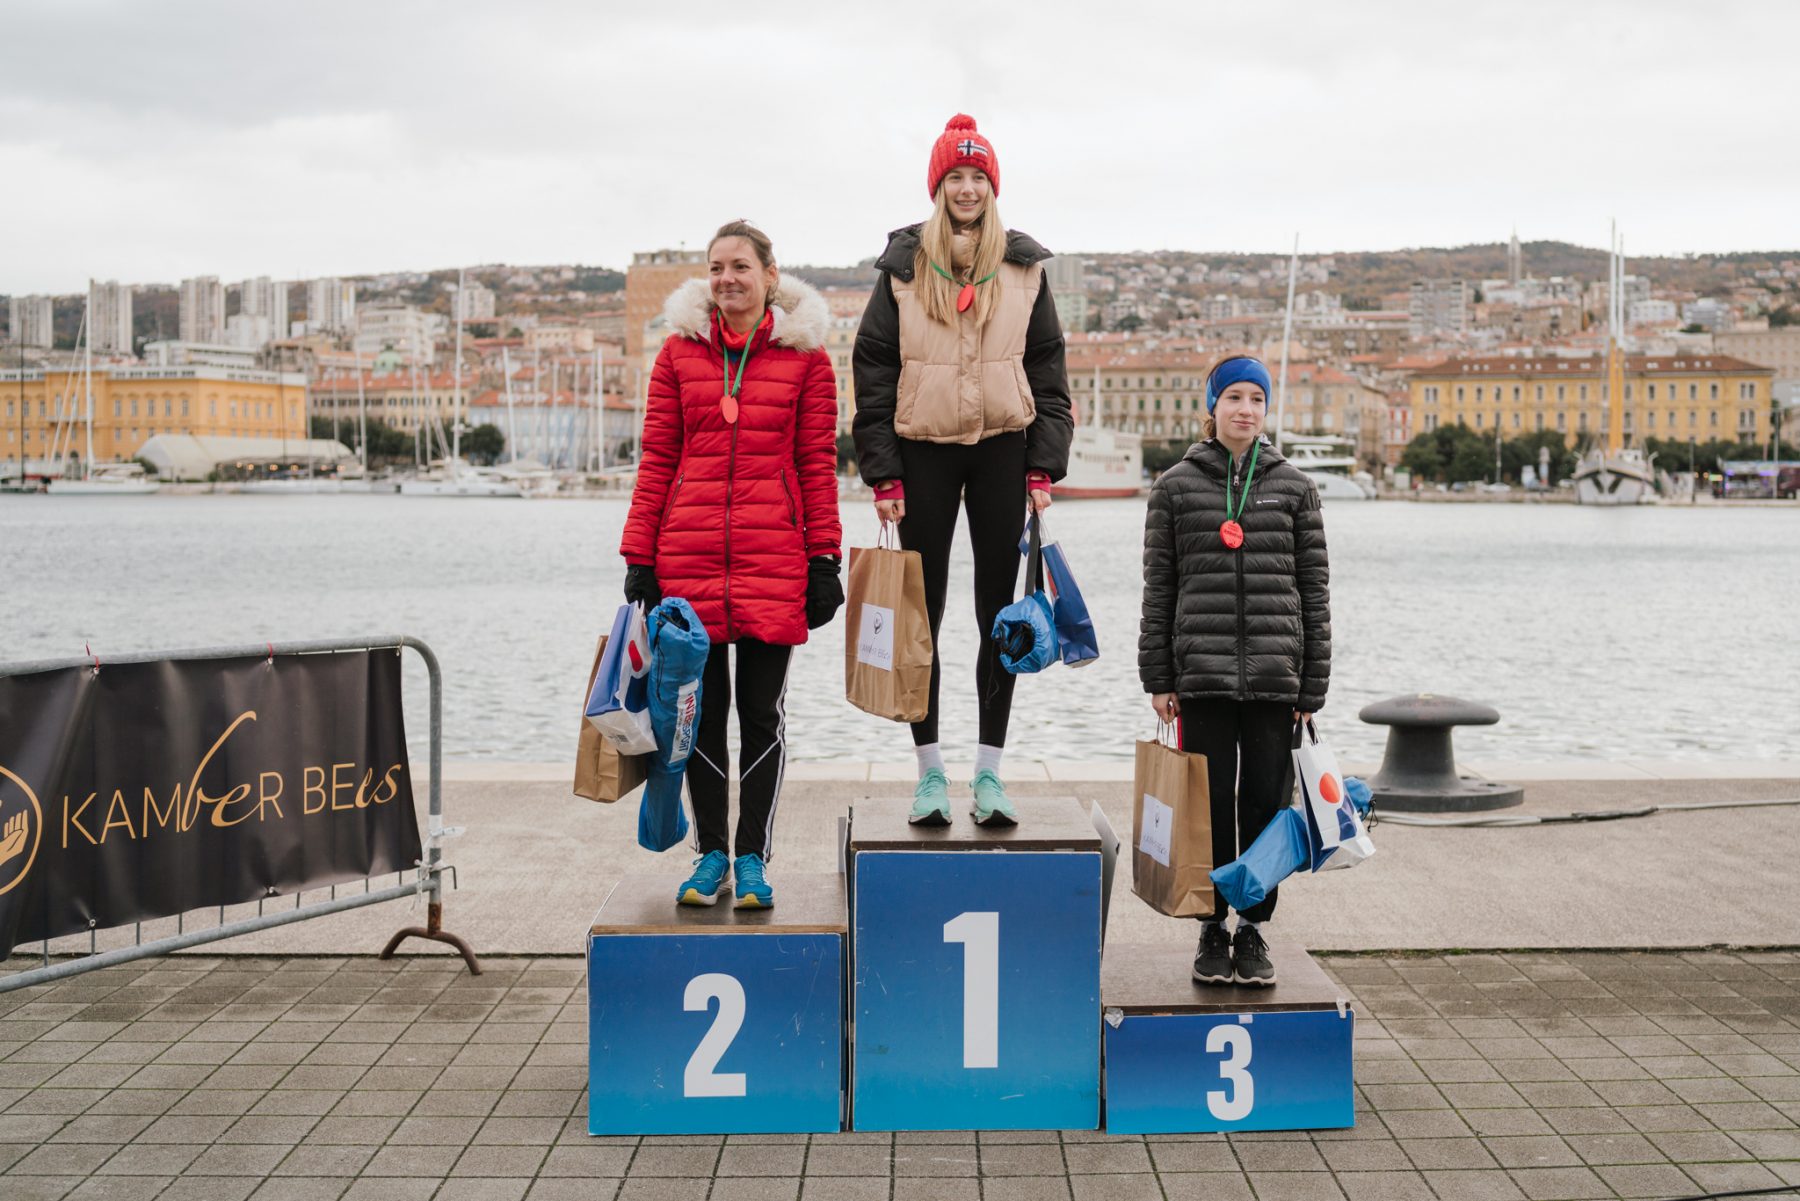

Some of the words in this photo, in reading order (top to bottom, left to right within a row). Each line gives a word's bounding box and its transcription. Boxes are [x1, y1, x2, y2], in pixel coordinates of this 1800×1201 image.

[683, 973, 746, 1097] 2
[943, 912, 999, 1068] 1
[1206, 1024, 1254, 1121] 3
